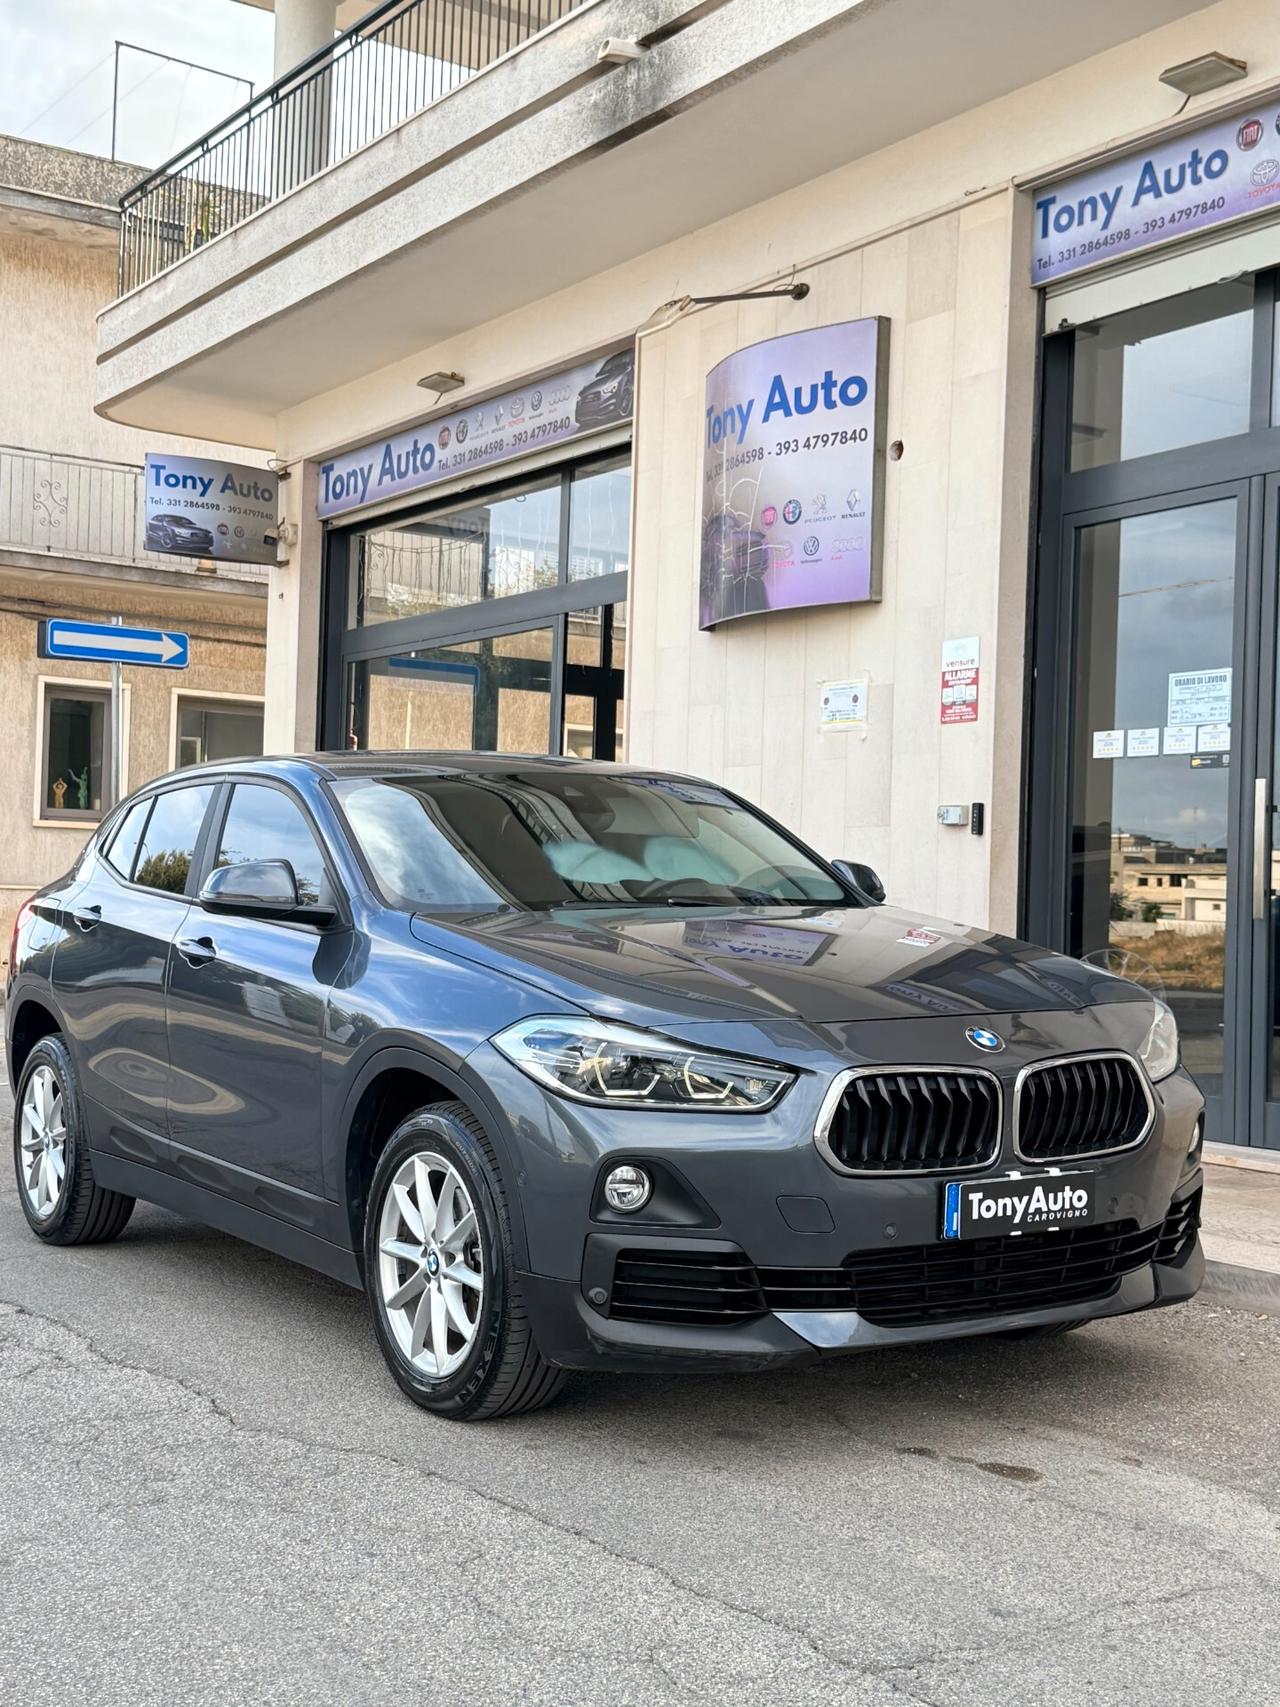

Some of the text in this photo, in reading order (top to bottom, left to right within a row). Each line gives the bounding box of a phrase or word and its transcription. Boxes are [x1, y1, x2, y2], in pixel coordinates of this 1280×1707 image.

[1036, 149, 1229, 240] Tony Auto
[1037, 255, 1055, 271] Tel.
[1058, 247, 1077, 263] 331
[1079, 228, 1131, 257] 2864598
[1142, 216, 1165, 235] 393
[1168, 196, 1225, 225] 4797840
[706, 370, 868, 449] Tony Auto
[438, 459, 450, 472] Tel.
[452, 452, 465, 467] 331
[467, 439, 504, 461] 2864598
[511, 431, 528, 447] 393
[529, 416, 571, 441] 4797840
[726, 447, 764, 471] 2864598
[776, 438, 799, 456] 393
[803, 427, 868, 451] 4797840
[150, 464, 273, 502] Tony Auto
[321, 438, 435, 504] Tony Auto
[150, 497, 164, 506] Tel.
[167, 498, 181, 507] 331
[184, 500, 220, 511] 2864598
[228, 506, 240, 514] 393
[243, 508, 273, 520] 4797840
[944, 669, 977, 681] ALLARME
[946, 658, 975, 668] verisure
[968, 1185, 1088, 1224] TonyAuto
[1027, 1209, 1088, 1223] CAROVIGNO
[454, 1310, 500, 1405] NEXEN
